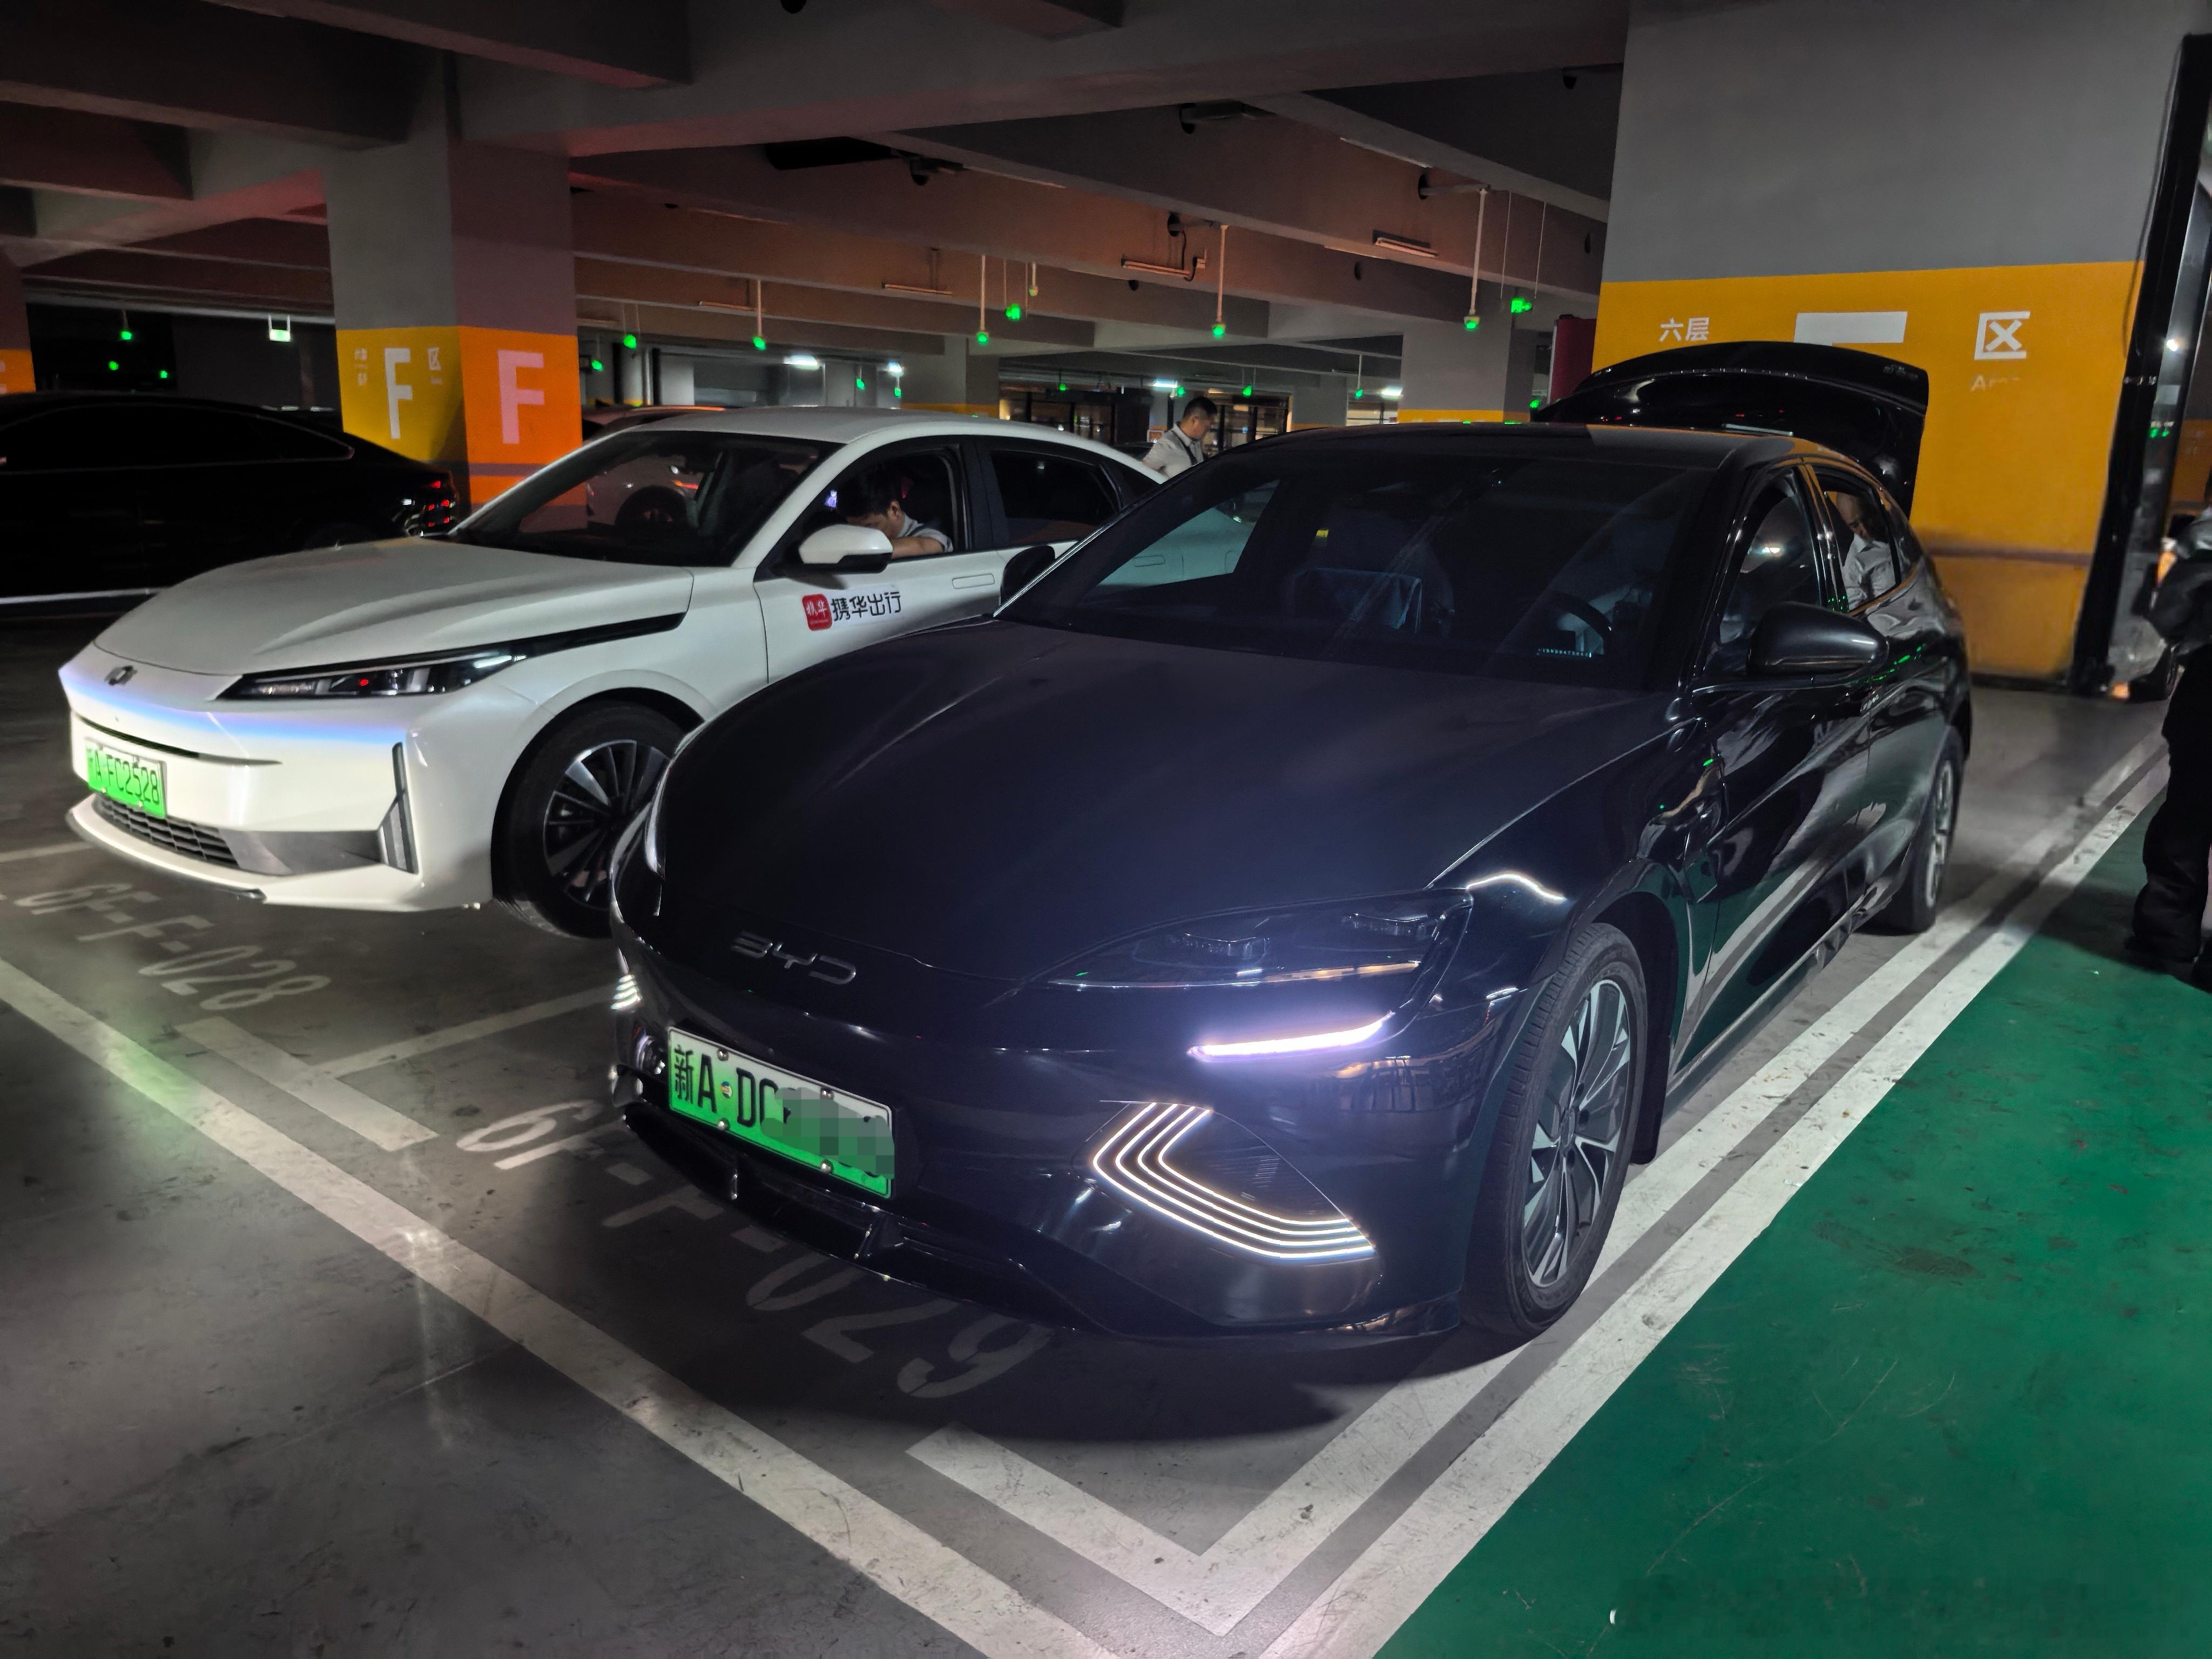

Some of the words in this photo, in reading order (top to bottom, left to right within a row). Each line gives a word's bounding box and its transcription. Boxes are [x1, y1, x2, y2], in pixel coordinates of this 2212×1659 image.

[1658, 317, 1710, 342] 六层
[1974, 311, 2031, 360] 区
[385, 347, 412, 439] F
[497, 350, 544, 444] F
[832, 592, 901, 621] 携华出行
[730, 930, 857, 986] BYD
